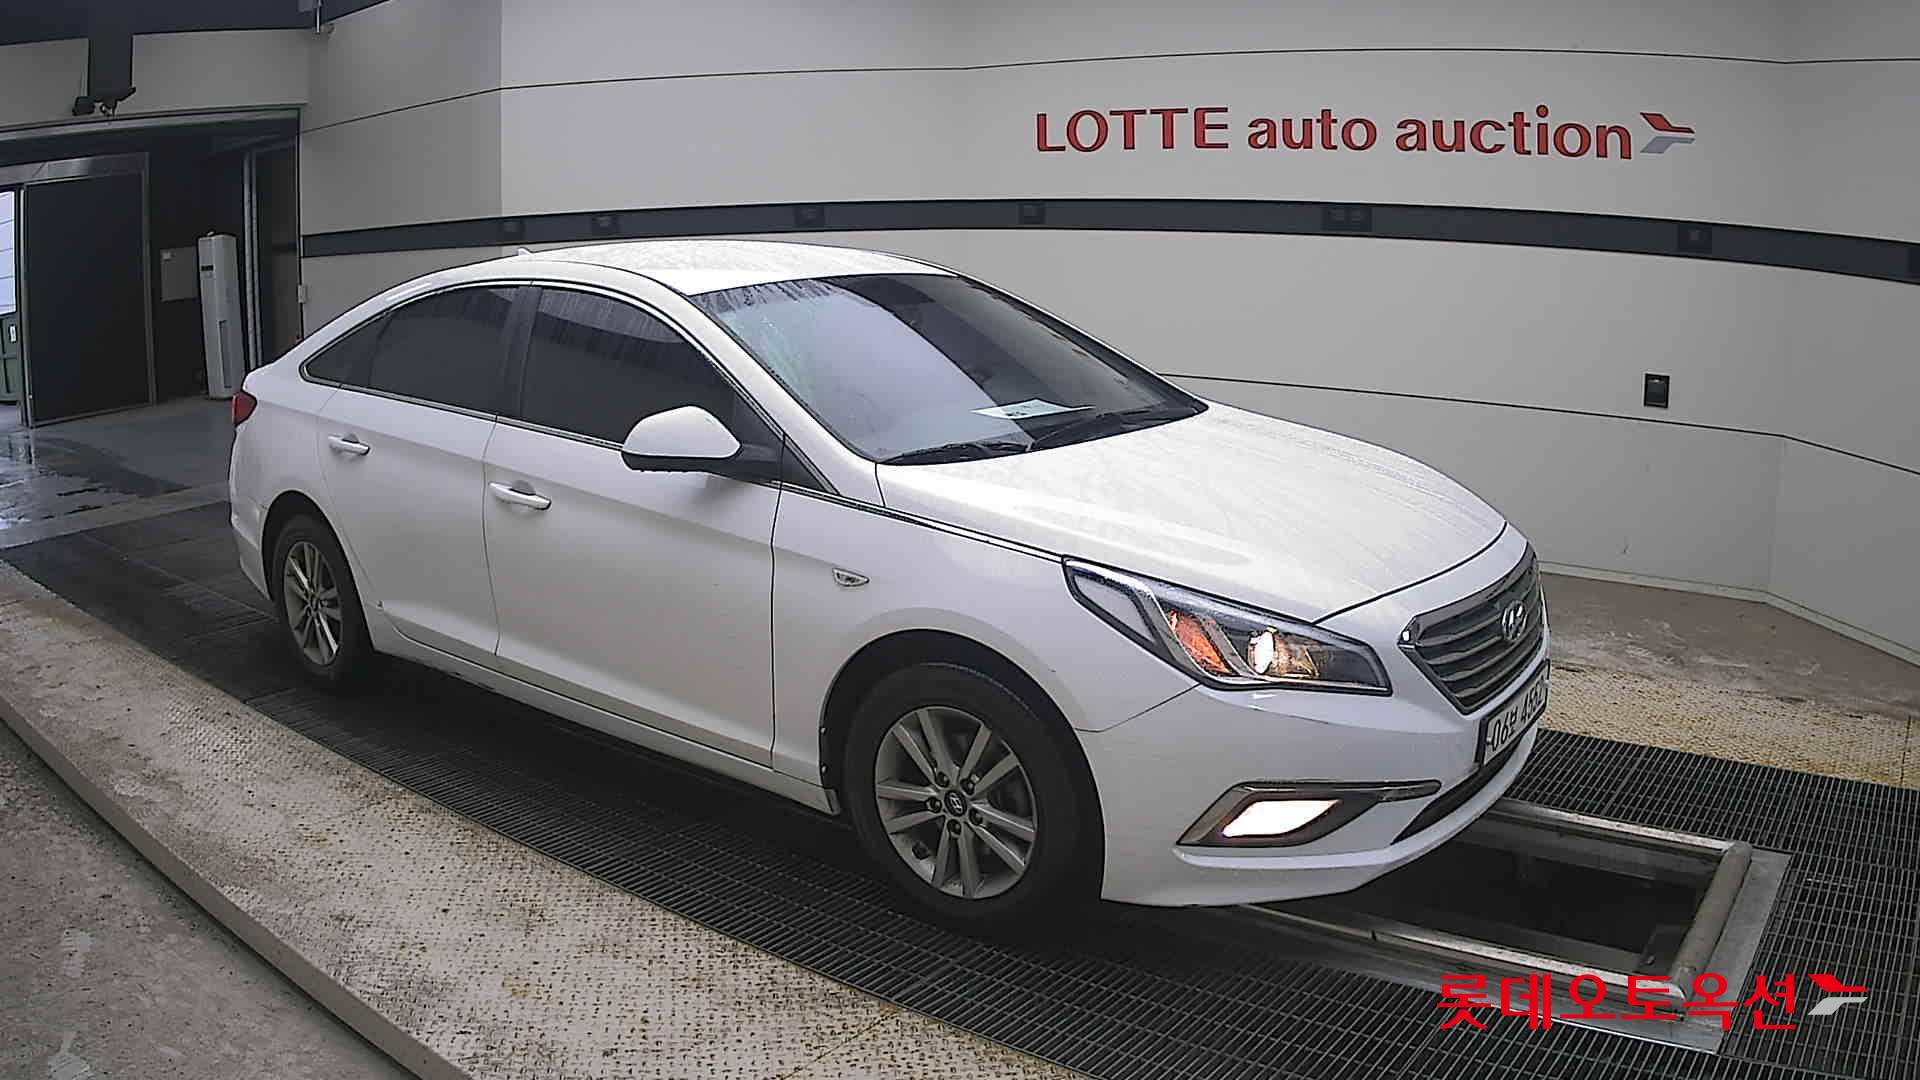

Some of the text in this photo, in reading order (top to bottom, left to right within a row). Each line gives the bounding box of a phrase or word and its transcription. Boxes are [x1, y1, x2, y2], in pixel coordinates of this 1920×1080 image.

[1036, 104, 1633, 160] LOTTE auto auction
